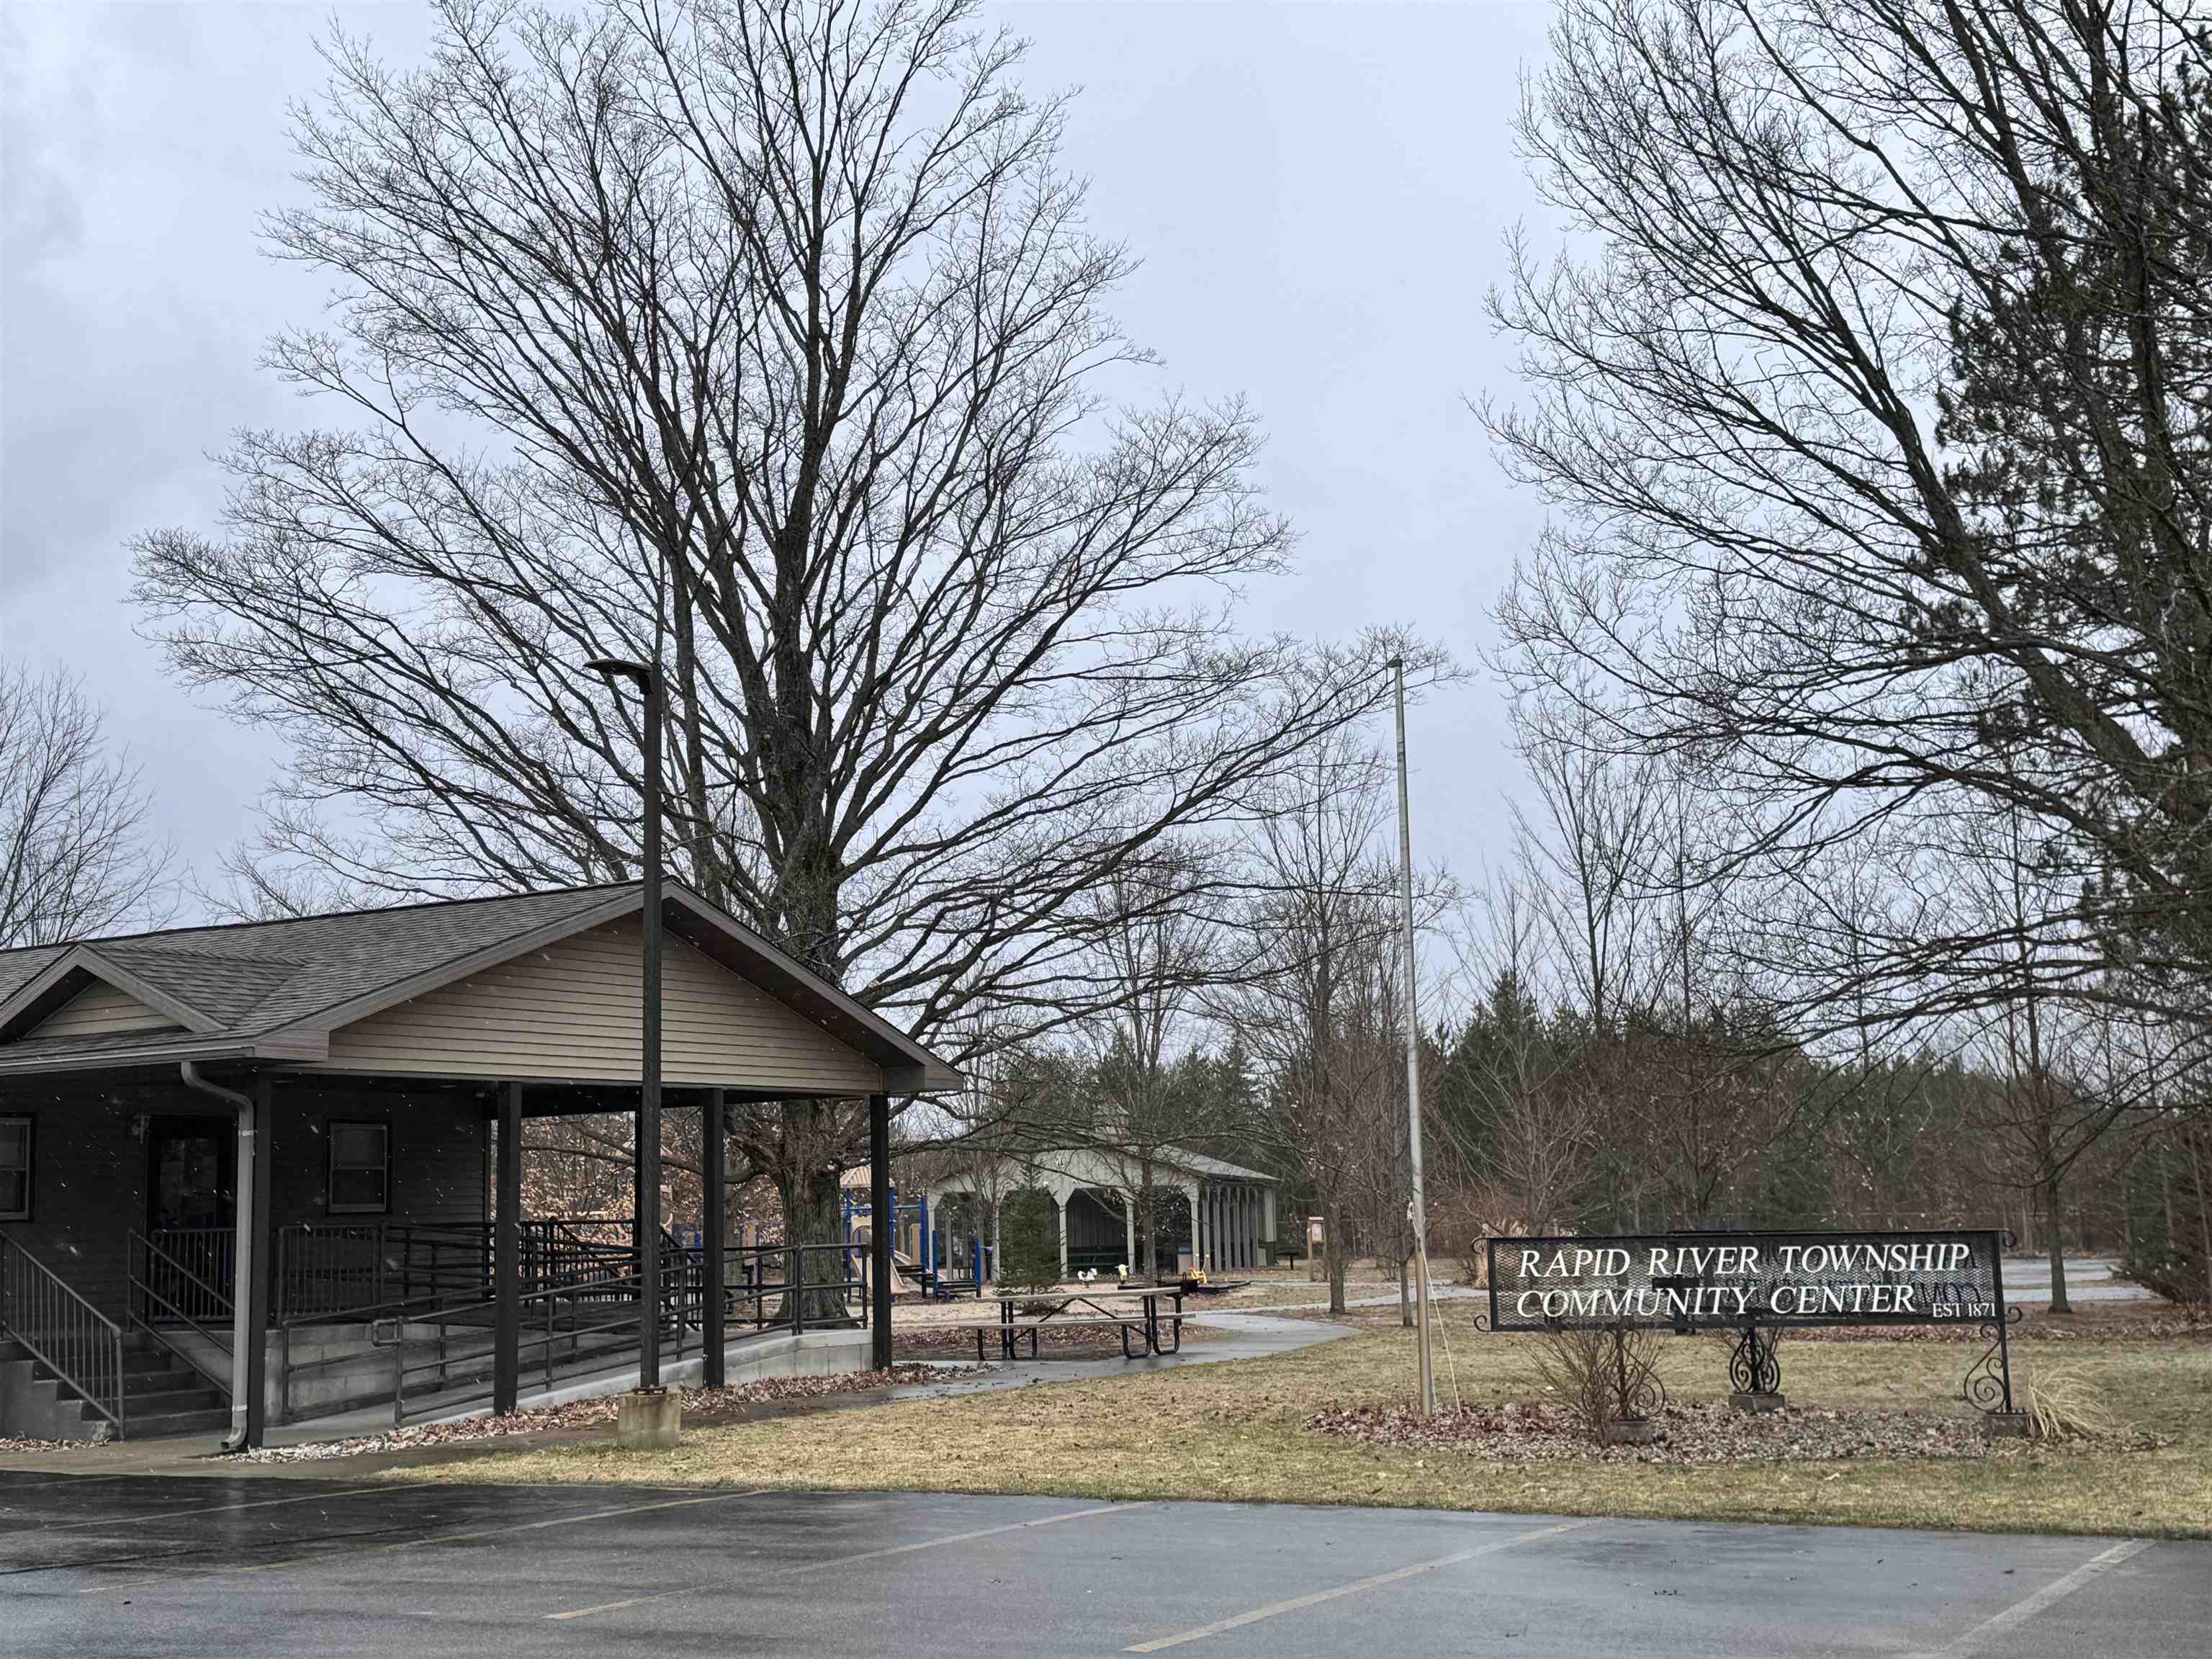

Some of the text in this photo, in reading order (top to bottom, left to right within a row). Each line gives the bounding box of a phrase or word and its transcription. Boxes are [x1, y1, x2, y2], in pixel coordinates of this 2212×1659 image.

[1517, 1244, 1970, 1277] RAPID RIVER TOWNSHIP
[1516, 1286, 1757, 1318] COMMUNITY
[1770, 1285, 1917, 1314] CENTER
[1932, 1302, 1997, 1318] EST 1871
